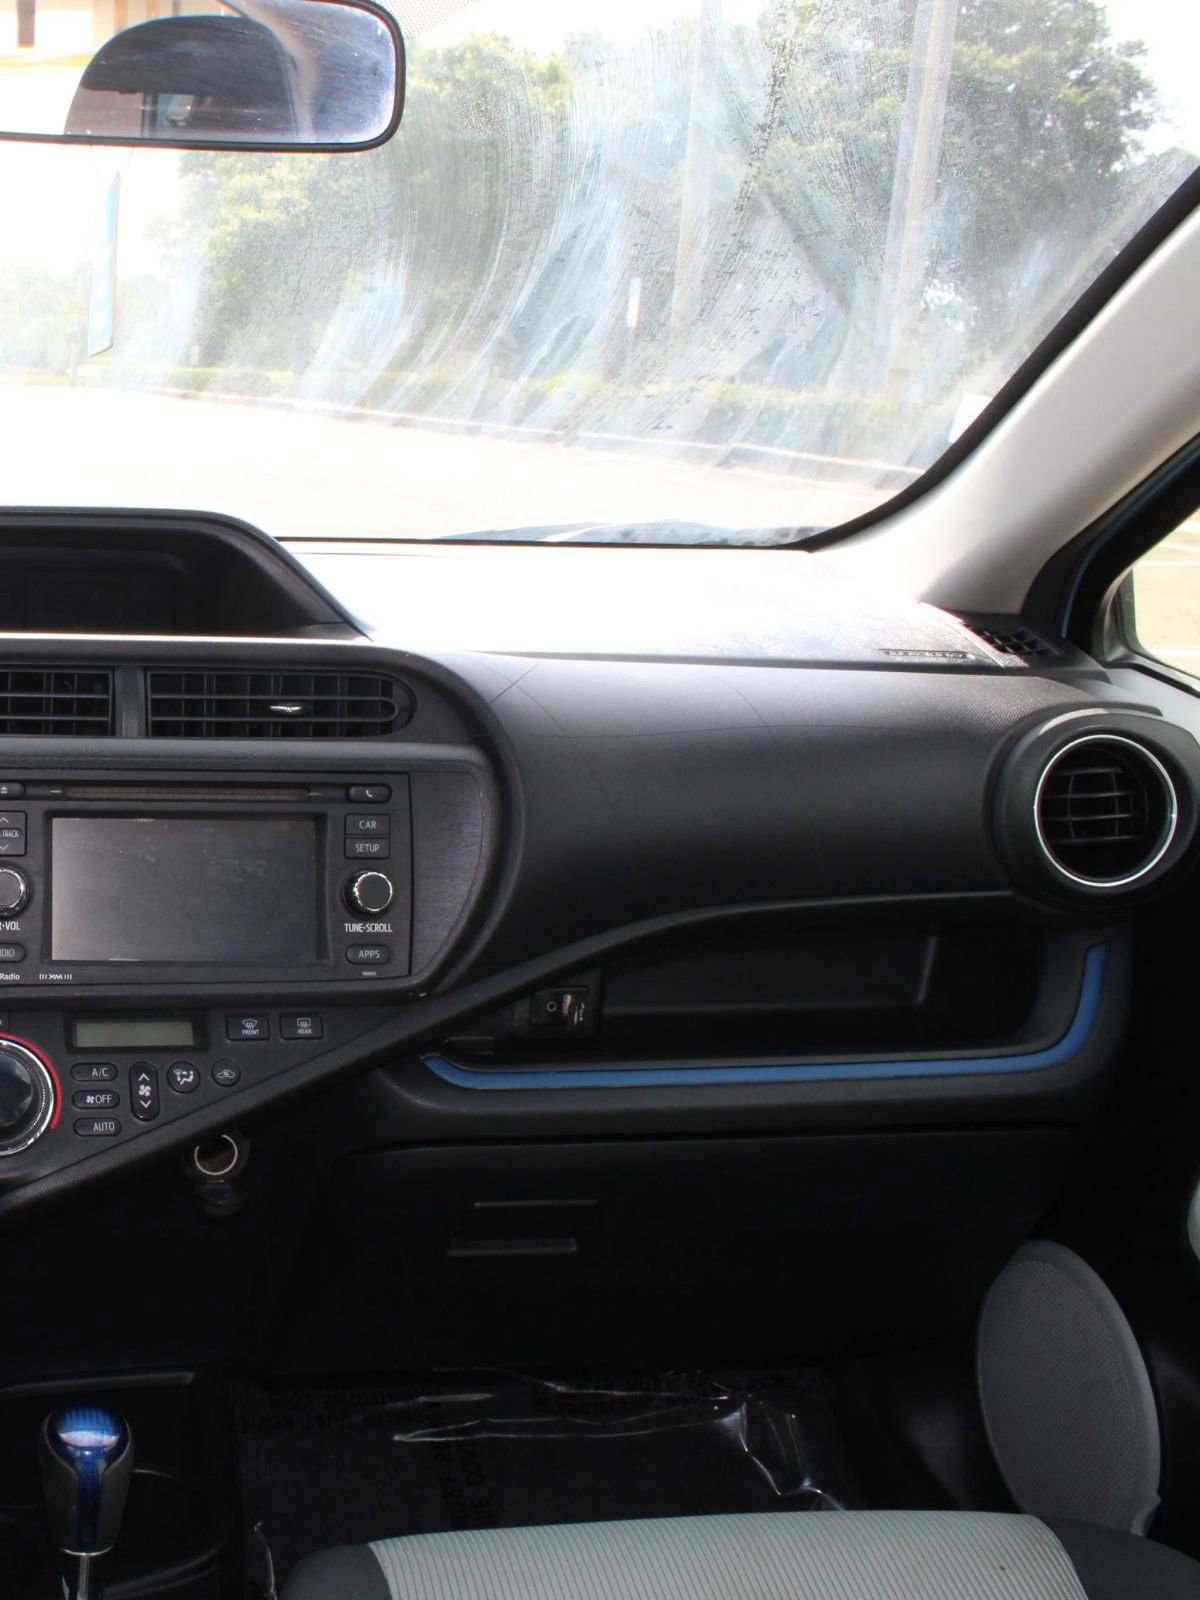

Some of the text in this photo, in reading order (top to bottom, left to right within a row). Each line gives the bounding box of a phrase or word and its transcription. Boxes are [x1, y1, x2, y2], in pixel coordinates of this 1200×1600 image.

[359, 820, 377, 830] CAR
[2, 829, 19, 838] TRACK
[355, 843, 380, 853] SETUP
[358, 950, 380, 959] APPS
[0, 973, 21, 981] Radio
[91, 1067, 109, 1077] A/C
[94, 1094, 113, 1104] OFF
[93, 1121, 116, 1132] AUTO
